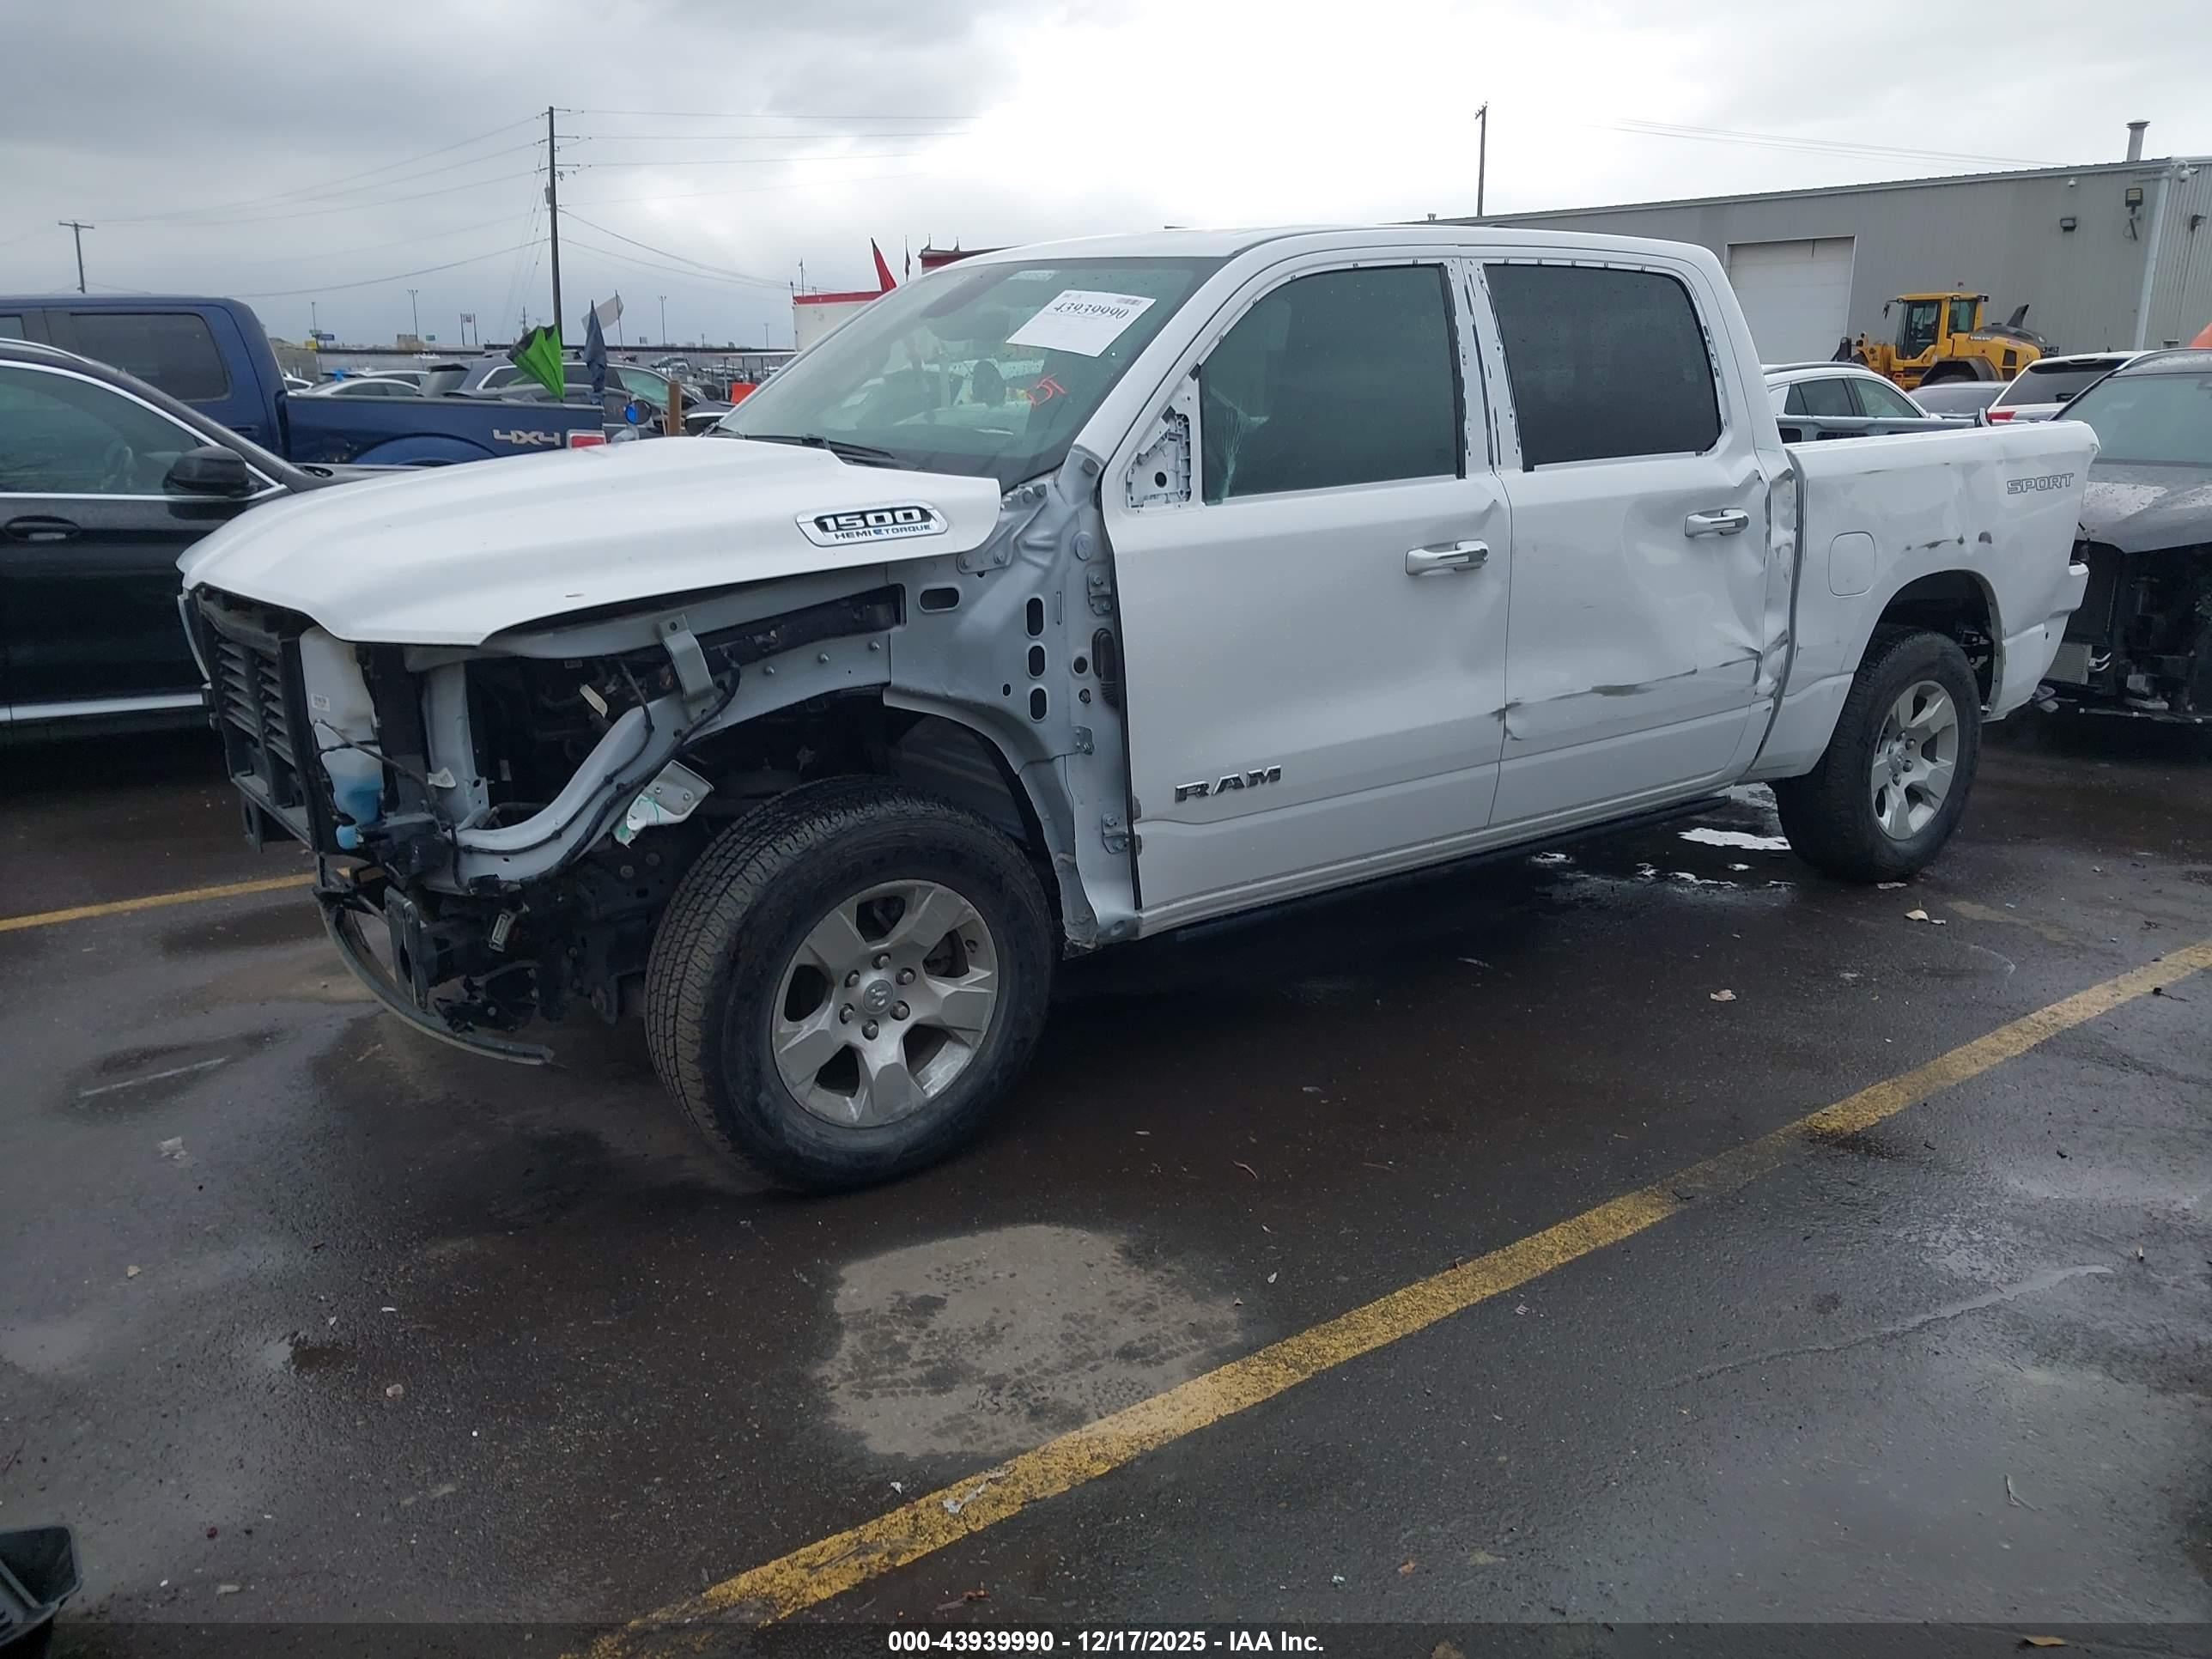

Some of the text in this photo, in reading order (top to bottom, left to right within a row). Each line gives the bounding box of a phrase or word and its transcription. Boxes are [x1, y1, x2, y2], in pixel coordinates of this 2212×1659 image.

[1054, 301, 1130, 319] 43939990
[2006, 472, 2075, 495] SPORT
[818, 507, 923, 532] 1500
[834, 529, 872, 540] HEMI
[1174, 764, 1282, 804] RAM
